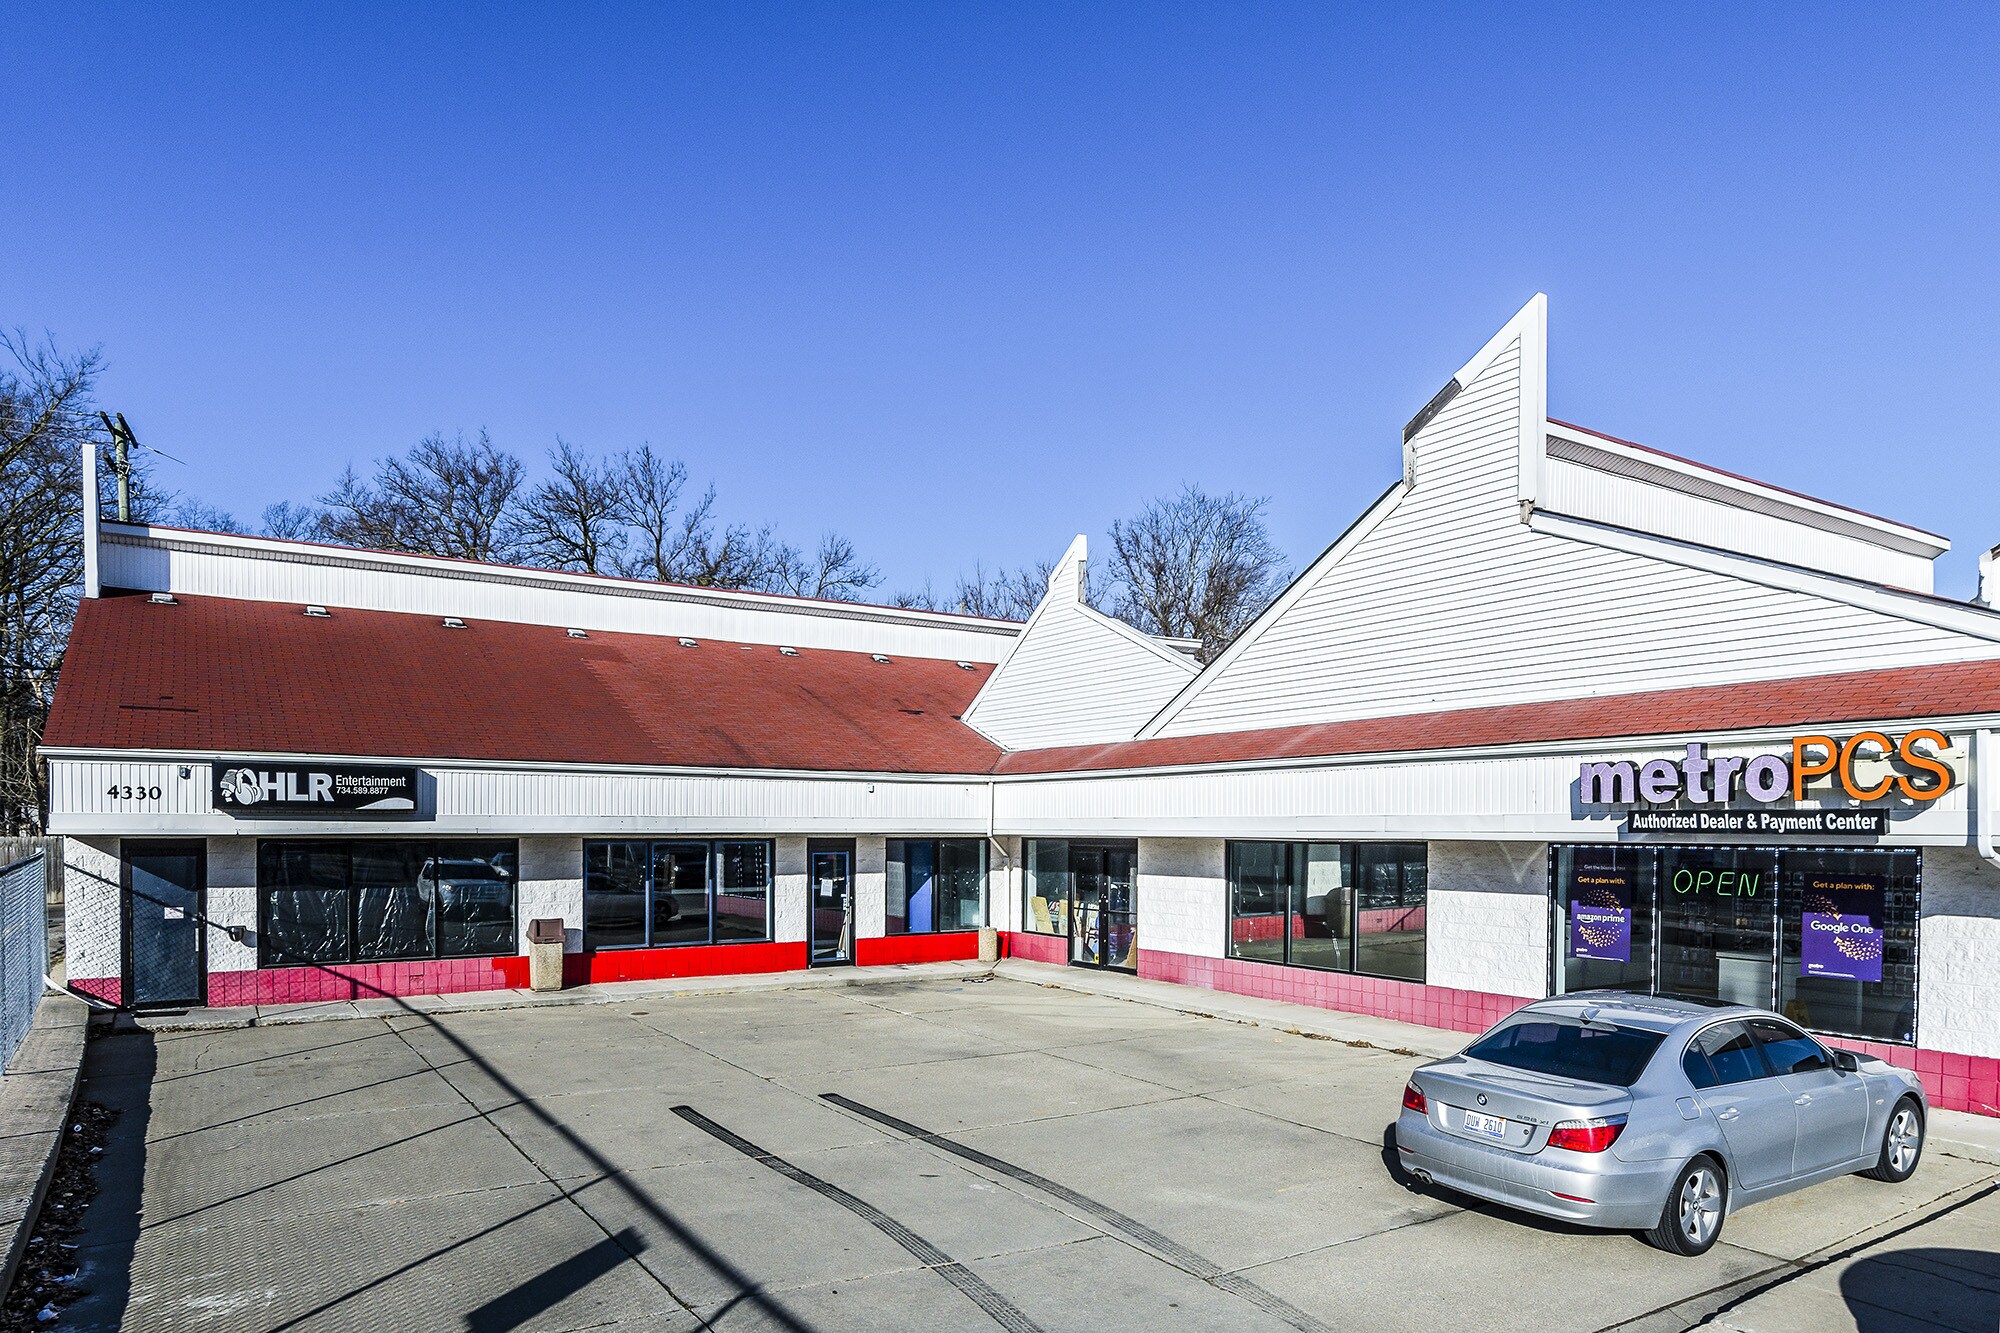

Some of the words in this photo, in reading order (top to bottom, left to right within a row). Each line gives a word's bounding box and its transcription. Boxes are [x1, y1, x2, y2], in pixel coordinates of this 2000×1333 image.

[1579, 729, 1955, 804] metroPCS
[259, 771, 334, 802] HLR
[335, 774, 407, 787] Entertainment
[106, 785, 162, 800] 4330
[336, 786, 389, 795] 734.589.8877
[1632, 813, 1698, 829] Authorized
[1700, 813, 1743, 829] Dealer
[1747, 813, 1758, 829] &
[1761, 813, 1822, 833] Payment
[1825, 813, 1878, 830] Center
[1577, 876, 1590, 884] Get
[1595, 877, 1609, 885] plan
[1609, 877, 1626, 885] with:
[1674, 869, 1759, 897] OPEN
[1812, 881, 1828, 889] Get
[1835, 881, 1853, 890] plan
[1854, 882, 1875, 890] with:
[1576, 913, 1602, 922] amazon
[1602, 914, 1626, 924] prime
[1810, 920, 1849, 934] Google
[1850, 923, 1874, 934] One
[1484, 1118, 1503, 1133] 2610
